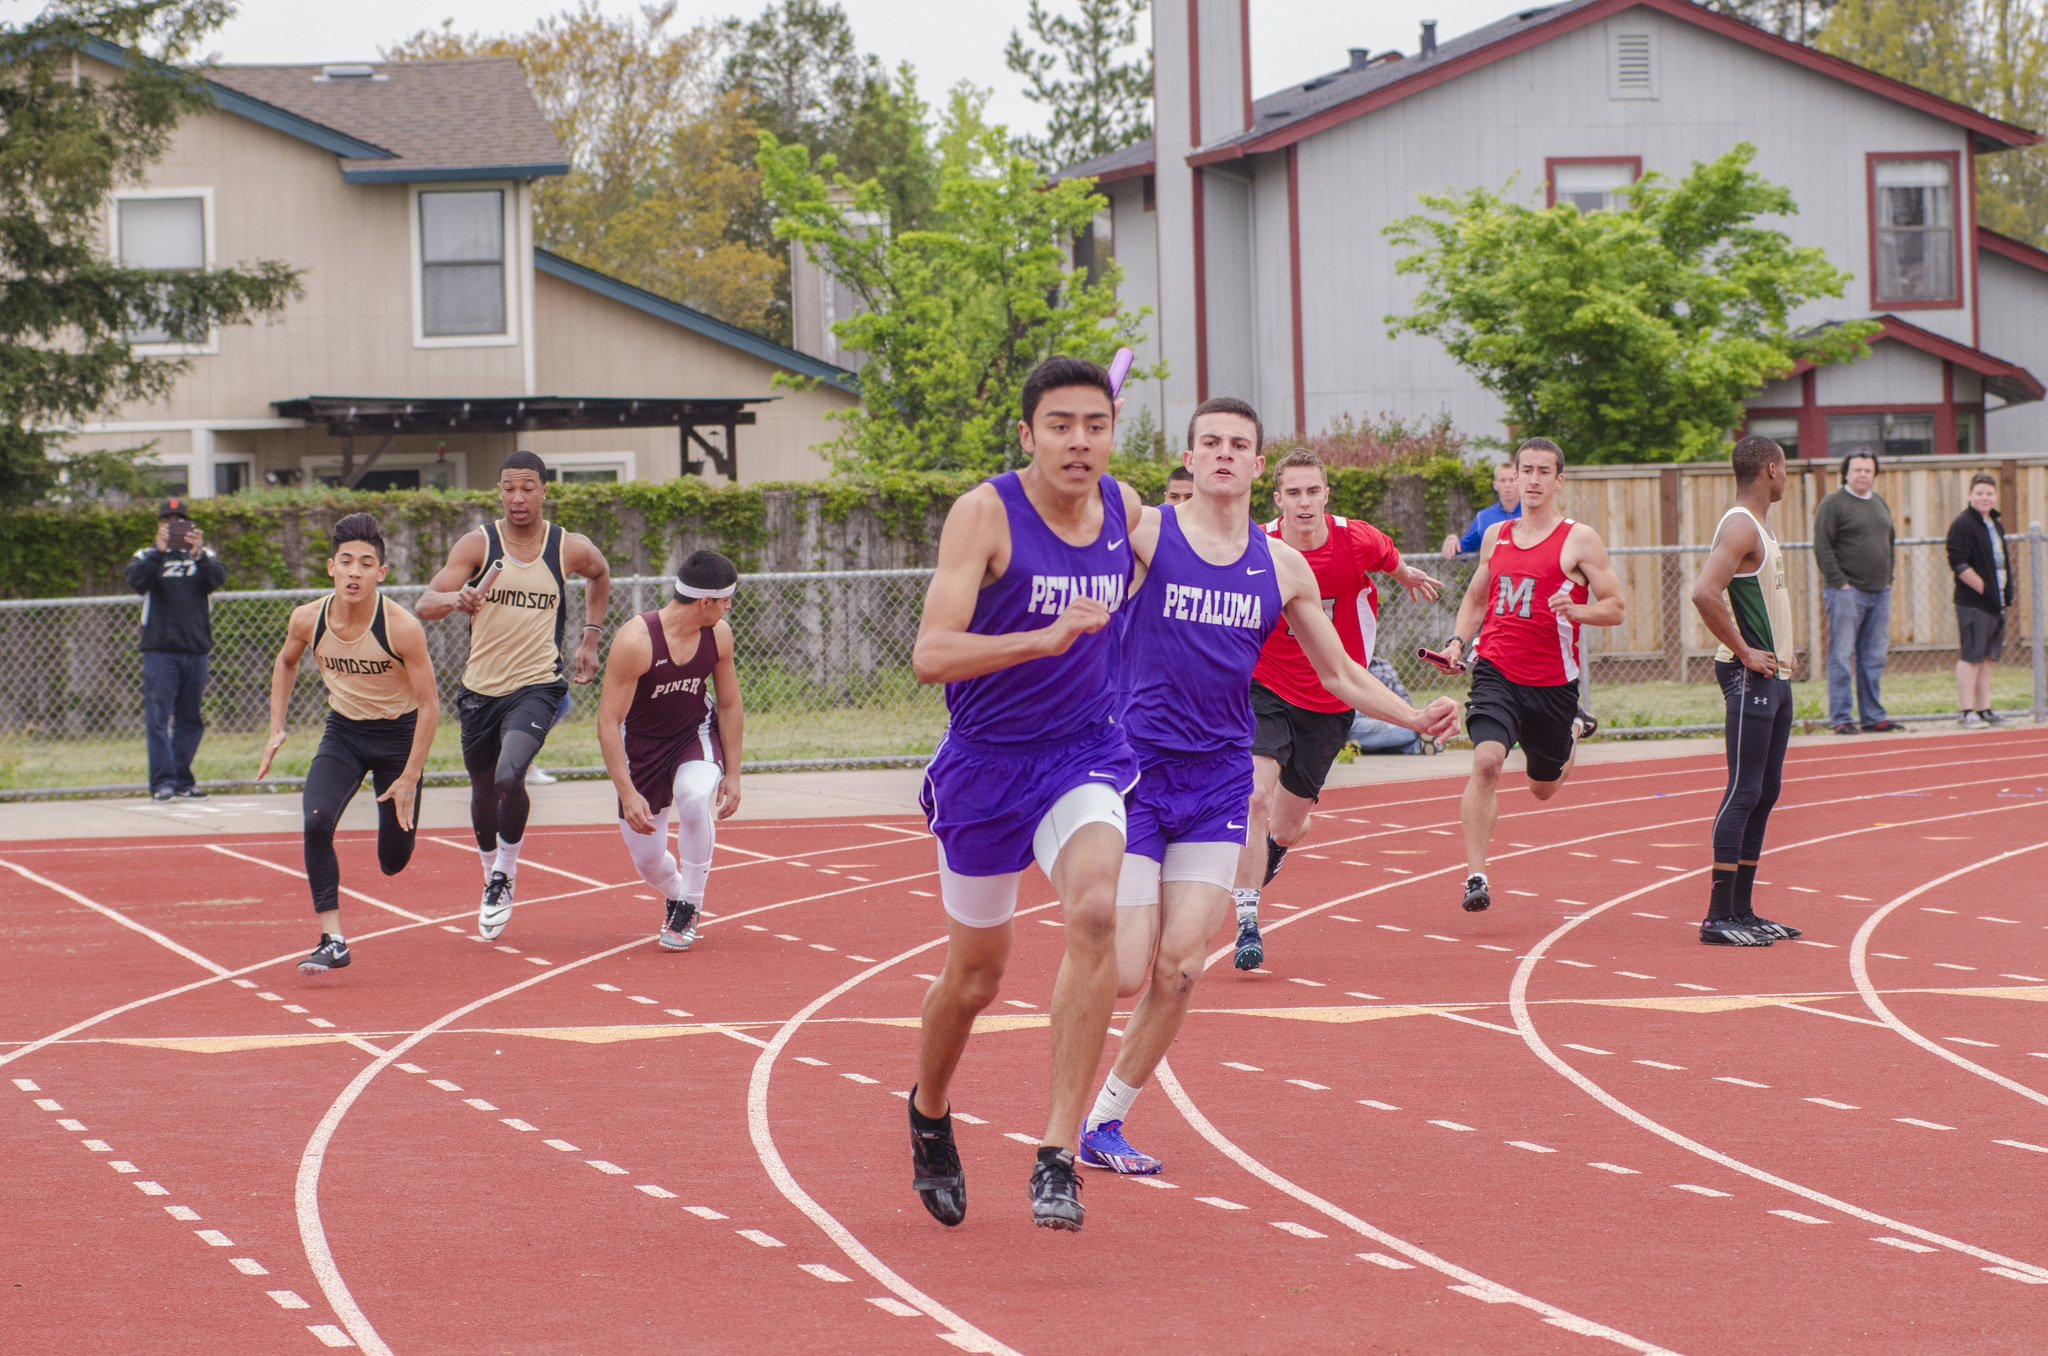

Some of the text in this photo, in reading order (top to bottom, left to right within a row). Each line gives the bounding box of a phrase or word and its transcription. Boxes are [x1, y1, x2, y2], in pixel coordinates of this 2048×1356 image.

[162, 560, 198, 577] 27
[485, 588, 557, 610] WINDSOR
[1162, 583, 1262, 629] PETALUMA
[1495, 574, 1537, 619] M
[650, 678, 701, 699] PINER
